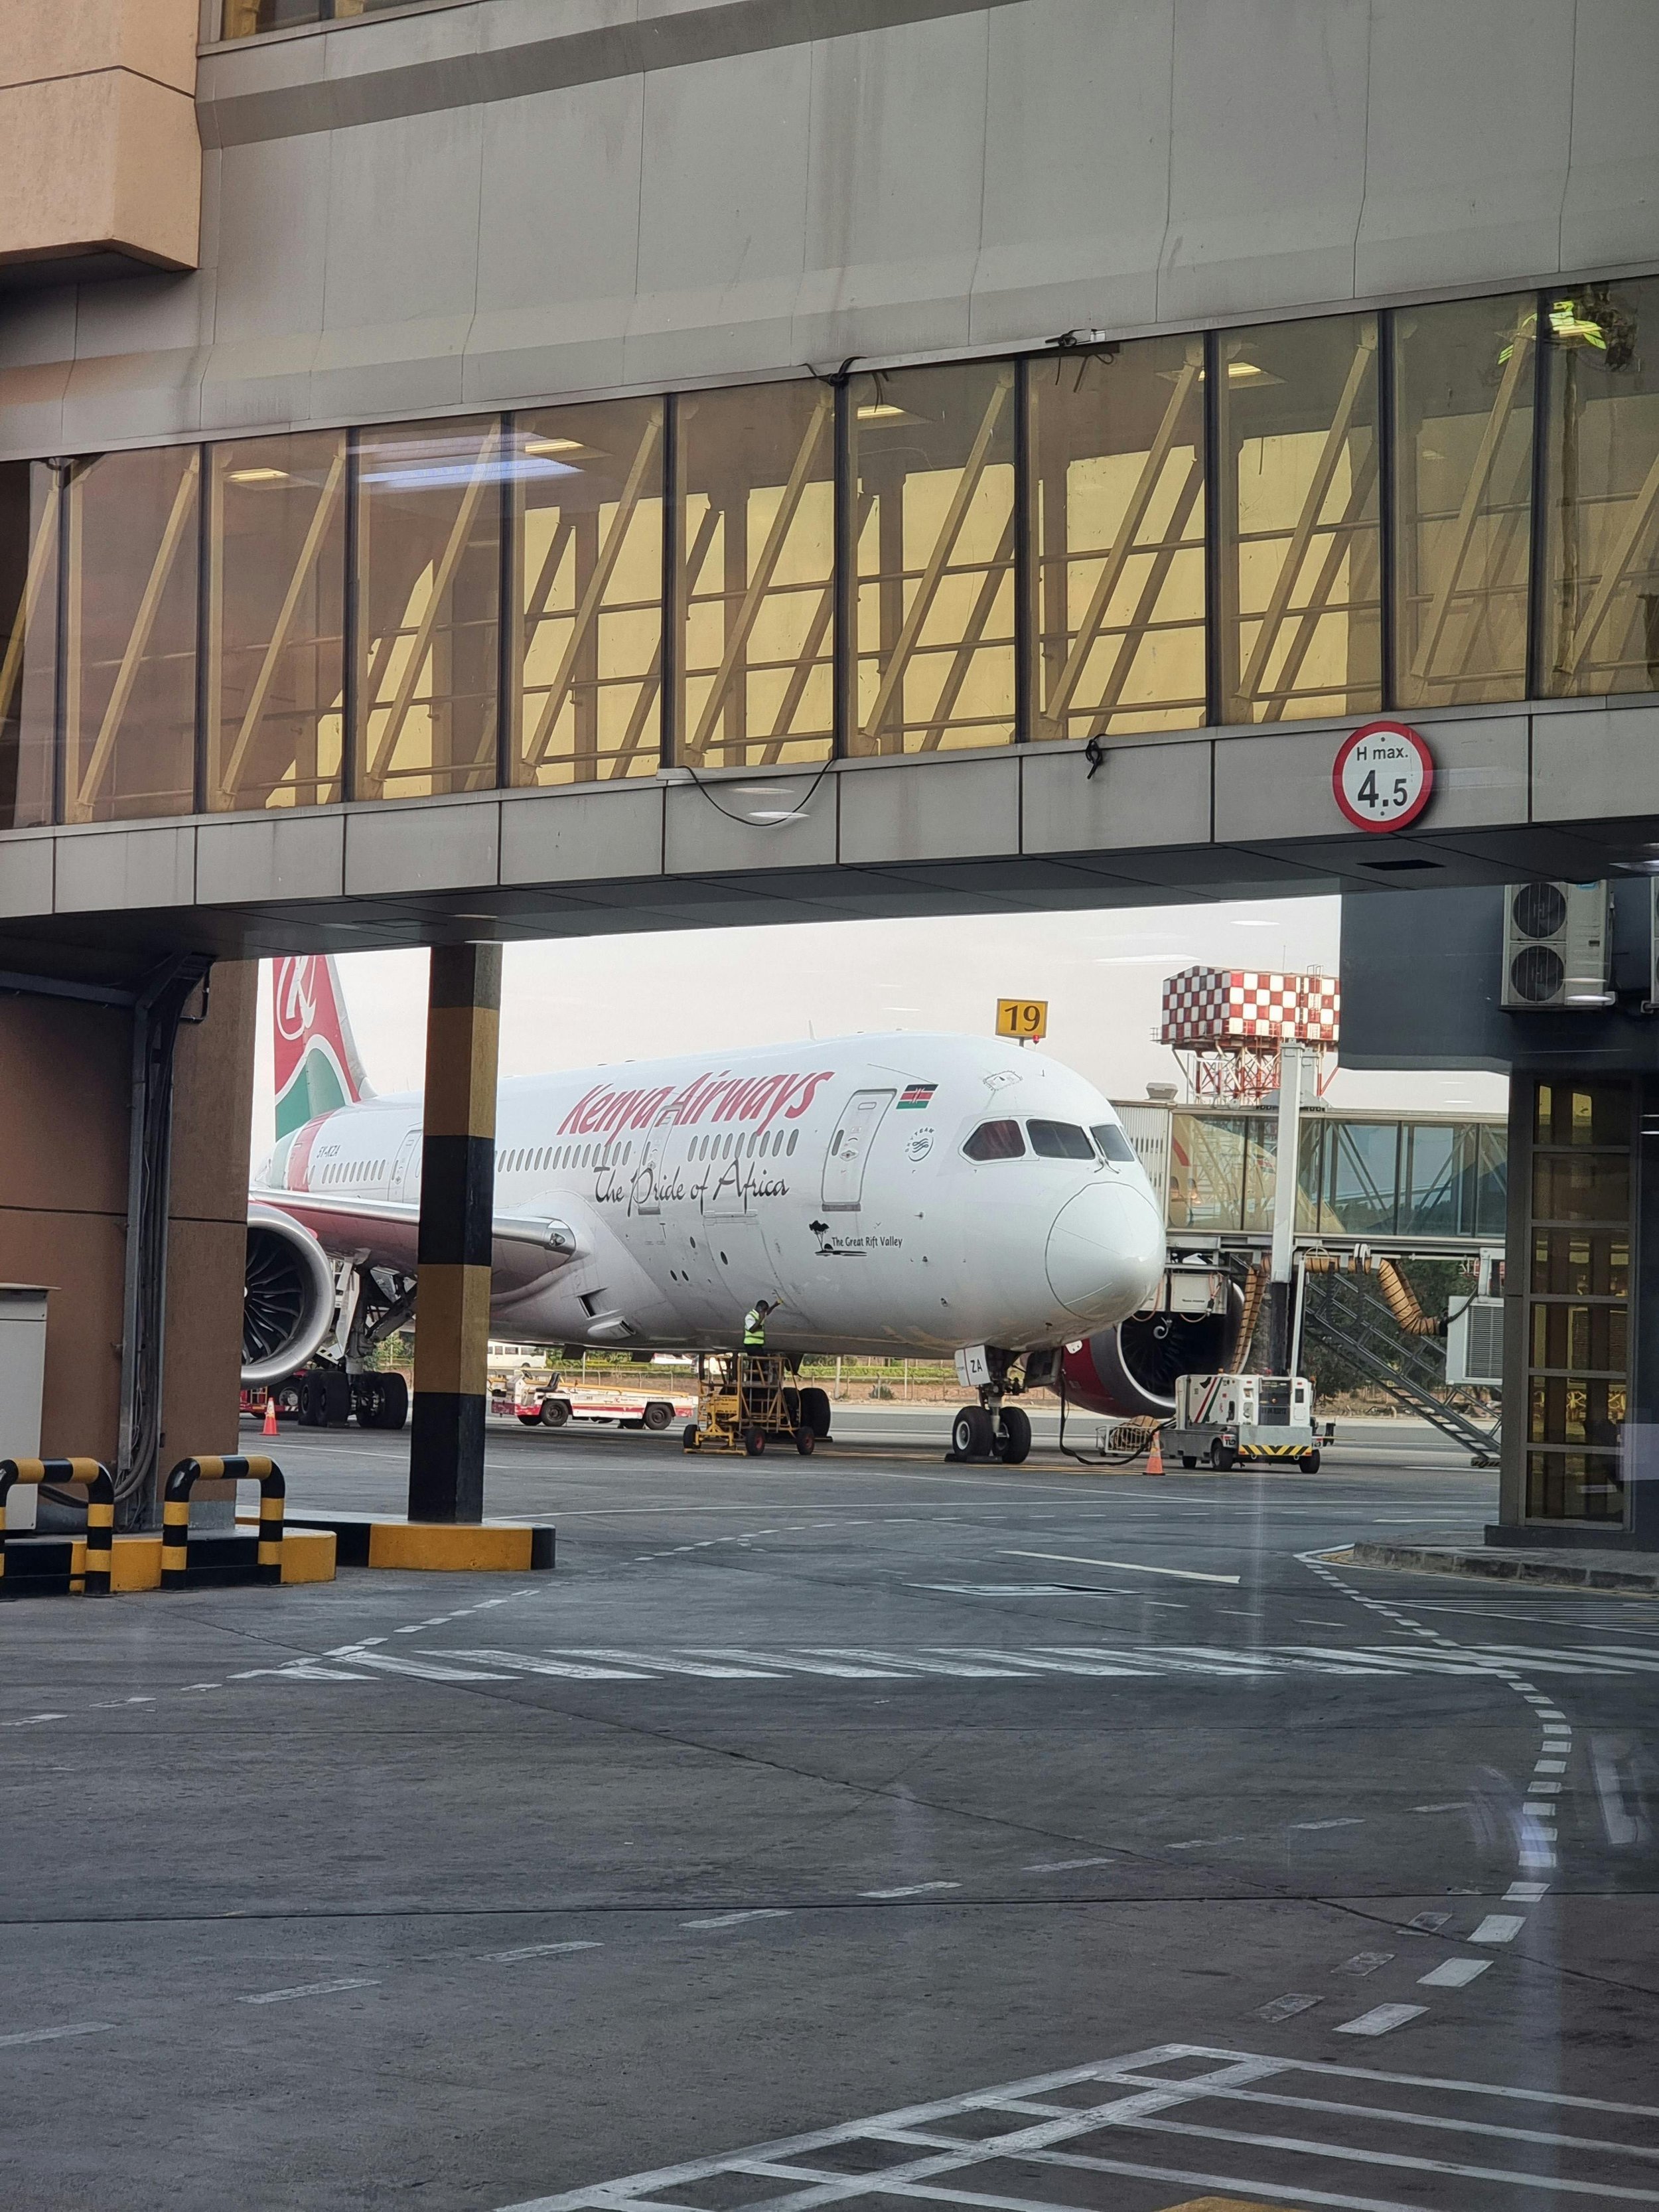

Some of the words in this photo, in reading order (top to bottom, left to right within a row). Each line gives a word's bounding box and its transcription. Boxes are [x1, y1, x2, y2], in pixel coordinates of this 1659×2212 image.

[1356, 746, 1367, 761] H
[1372, 747, 1408, 761] max.
[1357, 769, 1408, 808] 4.5
[1004, 1005, 1041, 1032] 19
[557, 1083, 677, 1147] Kenya
[655, 1070, 835, 1136] Airways
[593, 1165, 625, 1203] The
[627, 1165, 685, 1217] Pride
[690, 1163, 711, 1215] of
[712, 1157, 790, 1215] Africa
[831, 1236, 844, 1247] The
[845, 1236, 864, 1247] Great
[865, 1236, 879, 1248] Rift
[879, 1235, 903, 1248] Valley
[970, 1358, 983, 1374] ZA
